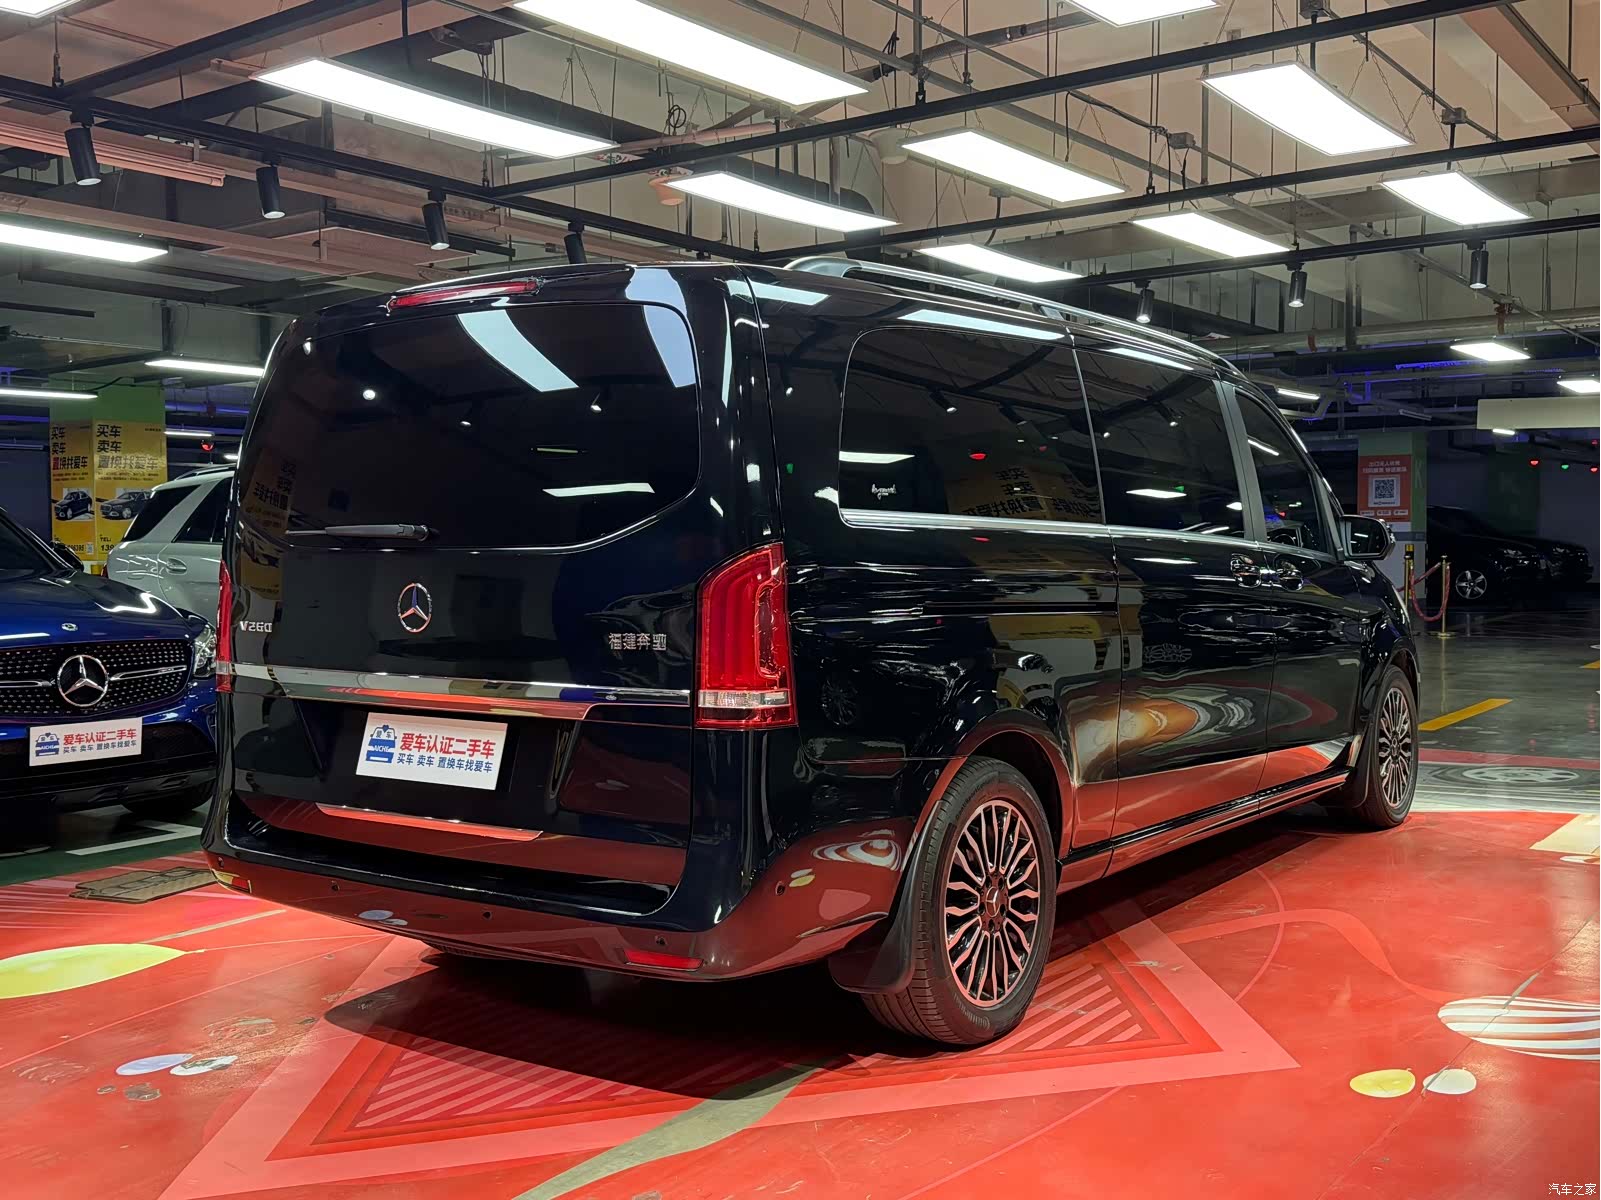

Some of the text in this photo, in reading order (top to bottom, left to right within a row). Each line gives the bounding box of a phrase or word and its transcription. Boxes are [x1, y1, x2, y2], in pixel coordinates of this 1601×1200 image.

[51, 426, 66, 440] 买车
[96, 424, 122, 439] 买车
[52, 442, 66, 455] 卖车
[97, 439, 122, 453] 卖车
[52, 455, 88, 471] 置换找爱车
[97, 455, 159, 470] 置换找爱车
[63, 728, 137, 745] 爱车认证二手车
[63, 745, 77, 754] 买车
[79, 744, 94, 752] 卖车
[400, 732, 497, 759] 爱车认证二手车
[397, 753, 494, 774] 买车 卖车 置换车找爱车
